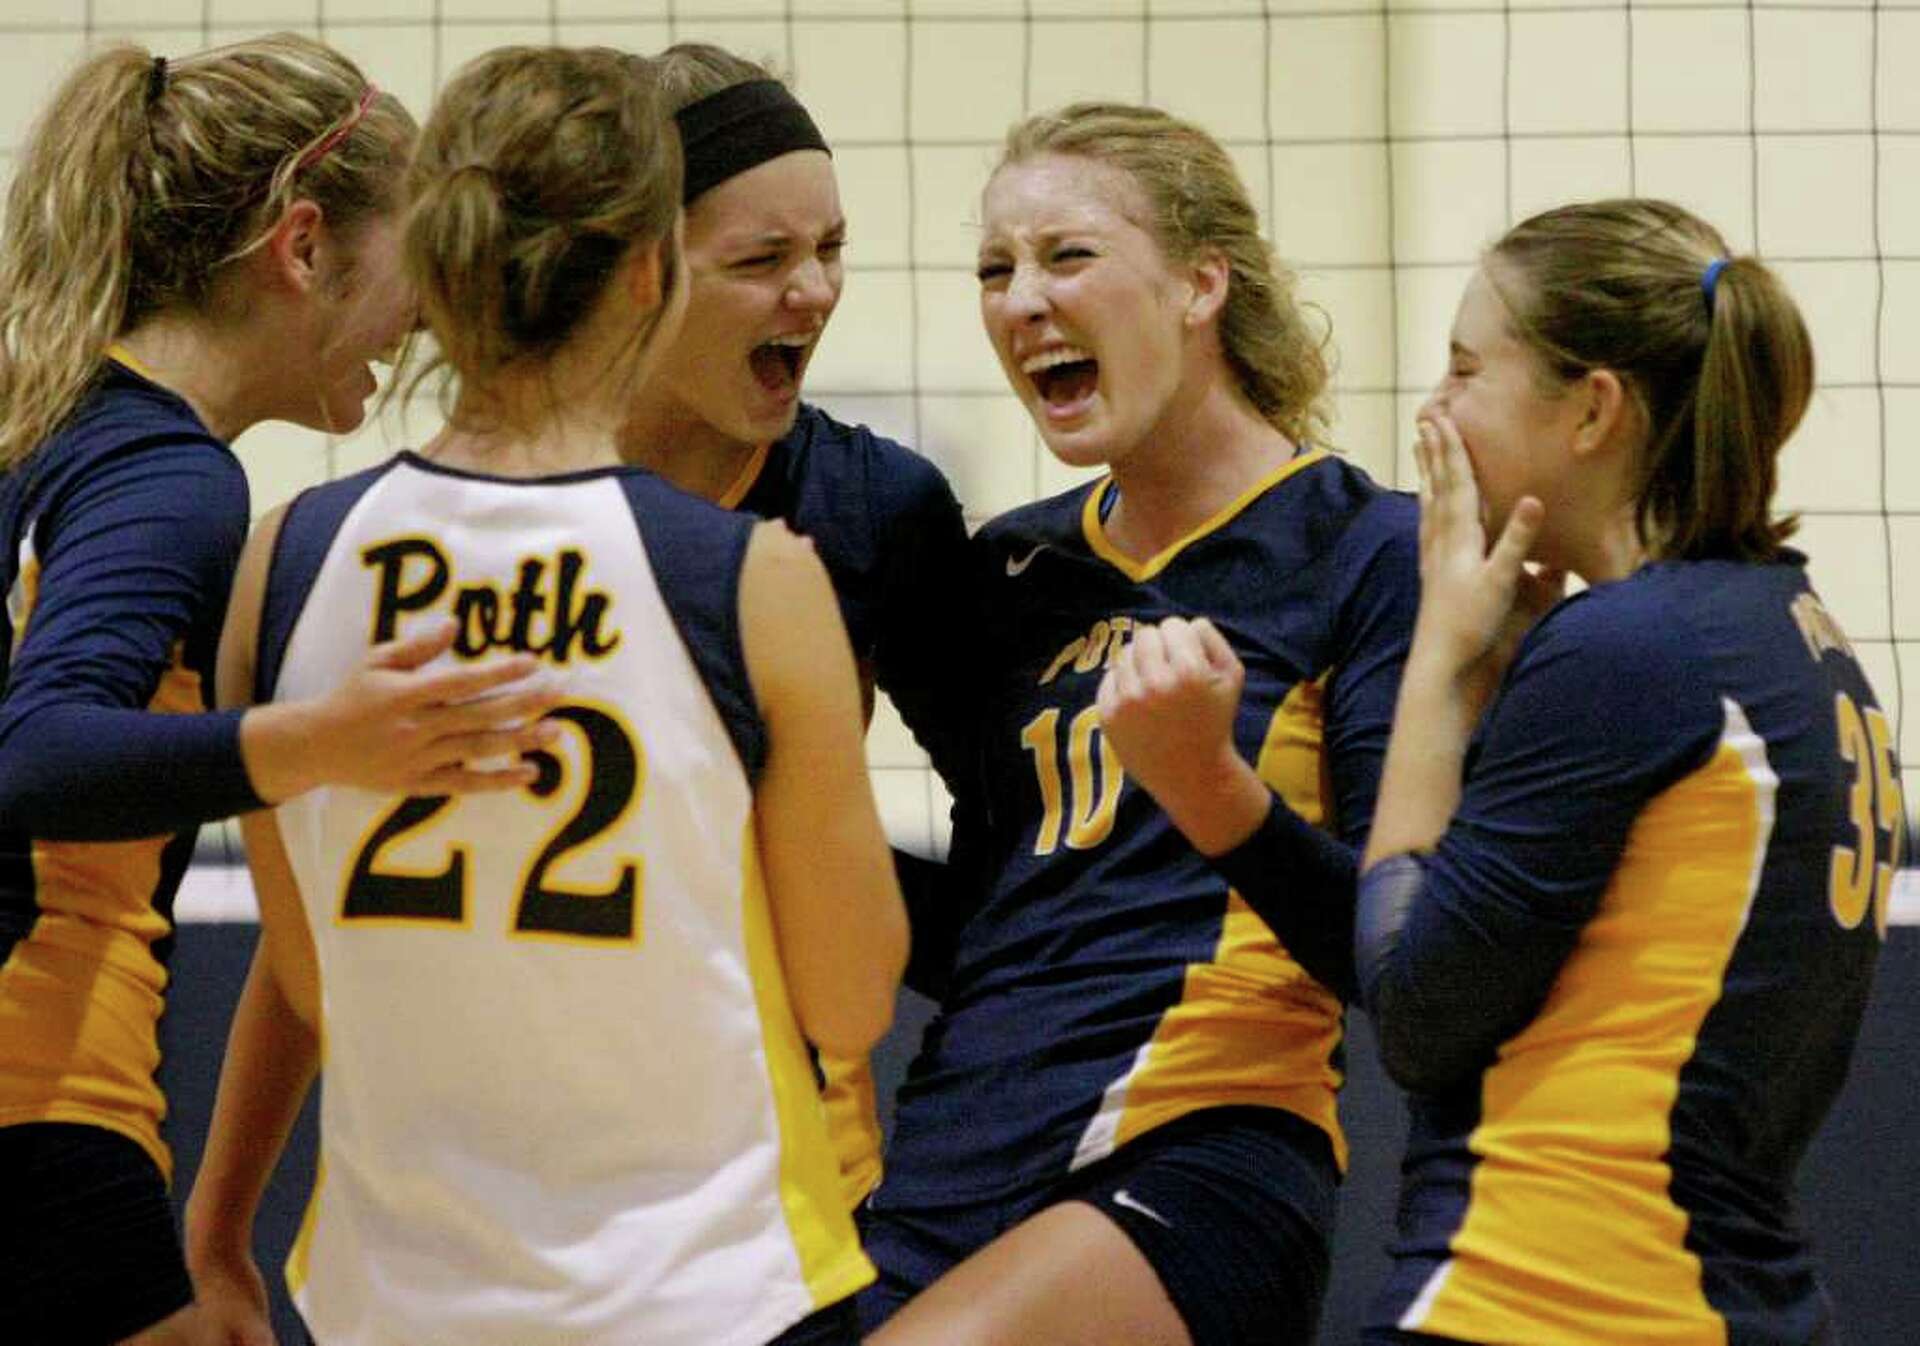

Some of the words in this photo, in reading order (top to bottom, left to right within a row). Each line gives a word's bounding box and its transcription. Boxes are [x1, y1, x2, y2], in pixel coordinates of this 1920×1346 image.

[361, 533, 621, 663] Poth
[335, 695, 644, 947] 22
[1021, 703, 1124, 856] 10
[1829, 691, 1901, 942] 35
